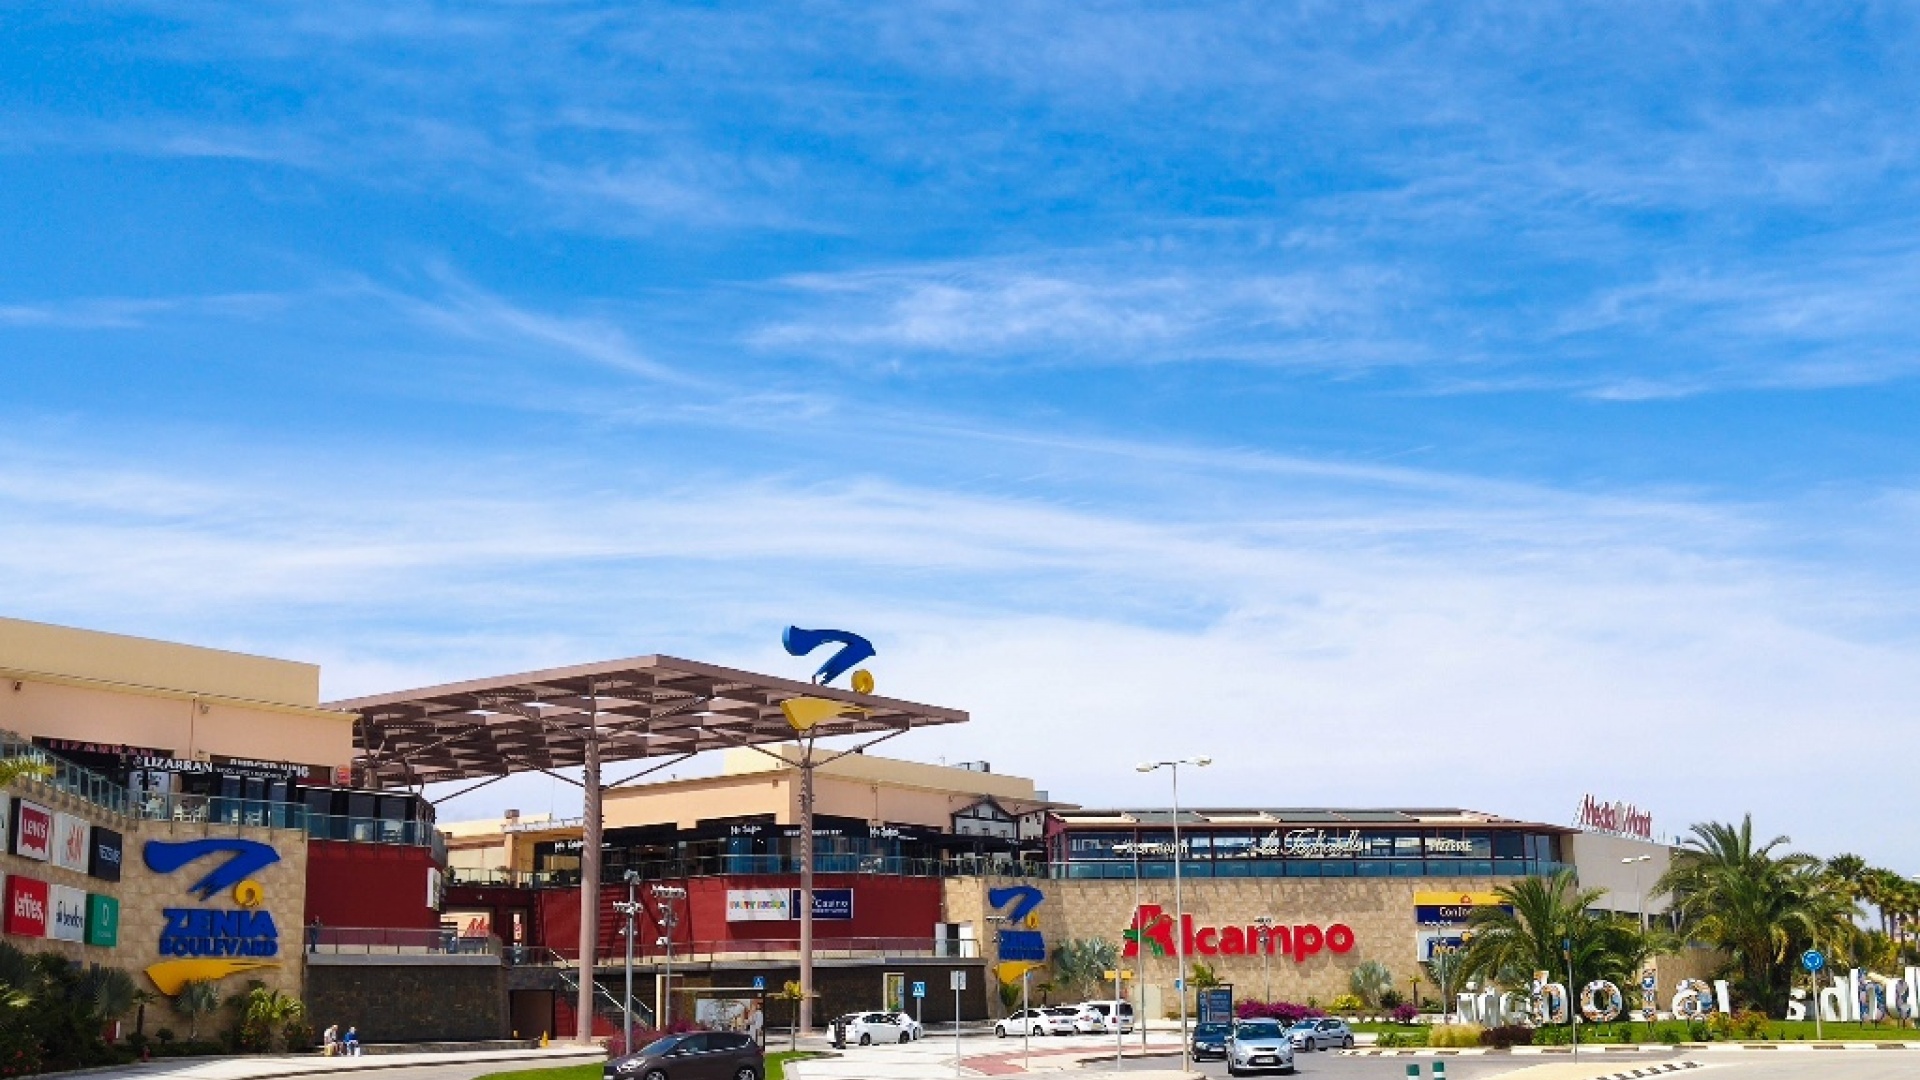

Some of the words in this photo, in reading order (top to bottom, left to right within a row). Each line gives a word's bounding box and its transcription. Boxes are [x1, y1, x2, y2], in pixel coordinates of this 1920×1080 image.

[144, 757, 212, 773] LIZARRAN
[161, 908, 278, 938] ZENIA
[1122, 904, 1355, 963] Alcampo
[159, 938, 278, 956] BOULEVARD
